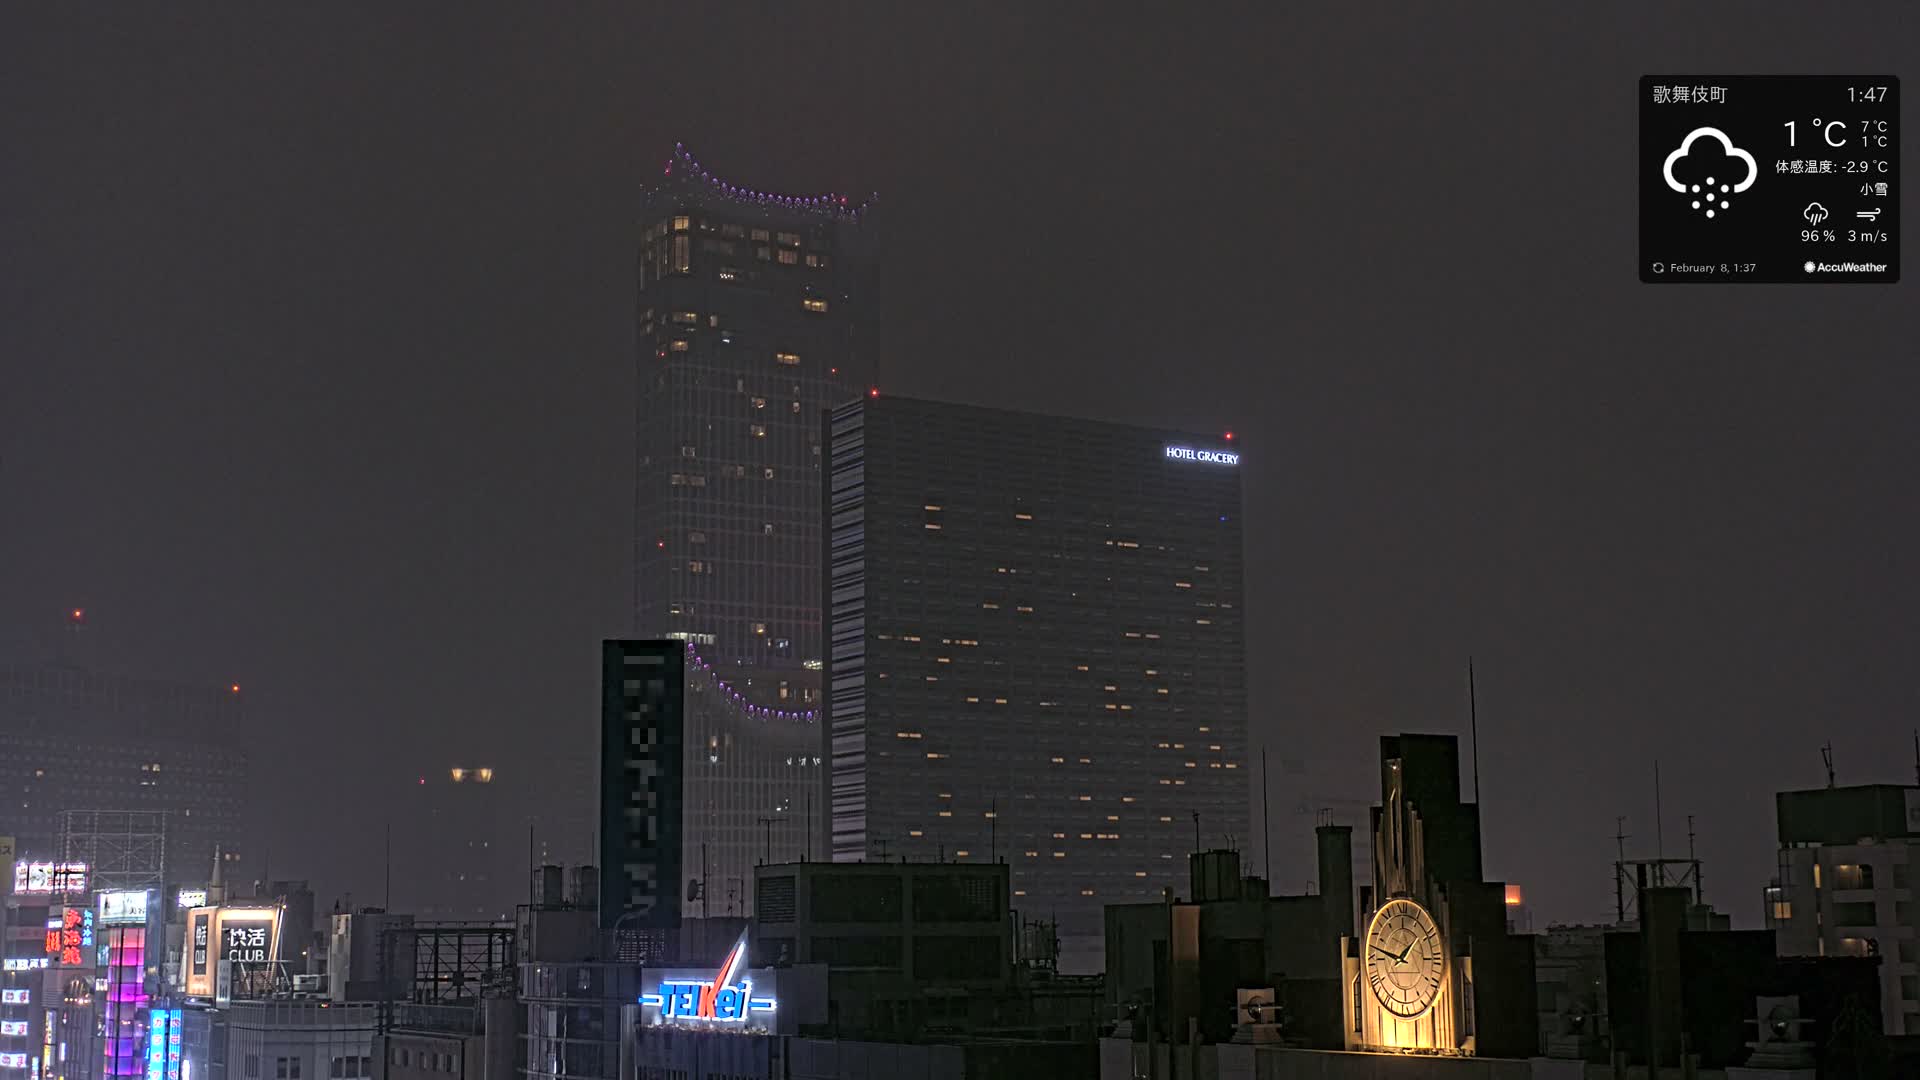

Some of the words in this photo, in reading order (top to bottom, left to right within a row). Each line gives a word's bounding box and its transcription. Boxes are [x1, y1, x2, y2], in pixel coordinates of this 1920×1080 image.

[1166, 447, 1196, 460] HOTEL
[1198, 450, 1238, 465] GRACERY
[230, 928, 266, 947] 快活
[229, 949, 264, 962] CLUB
